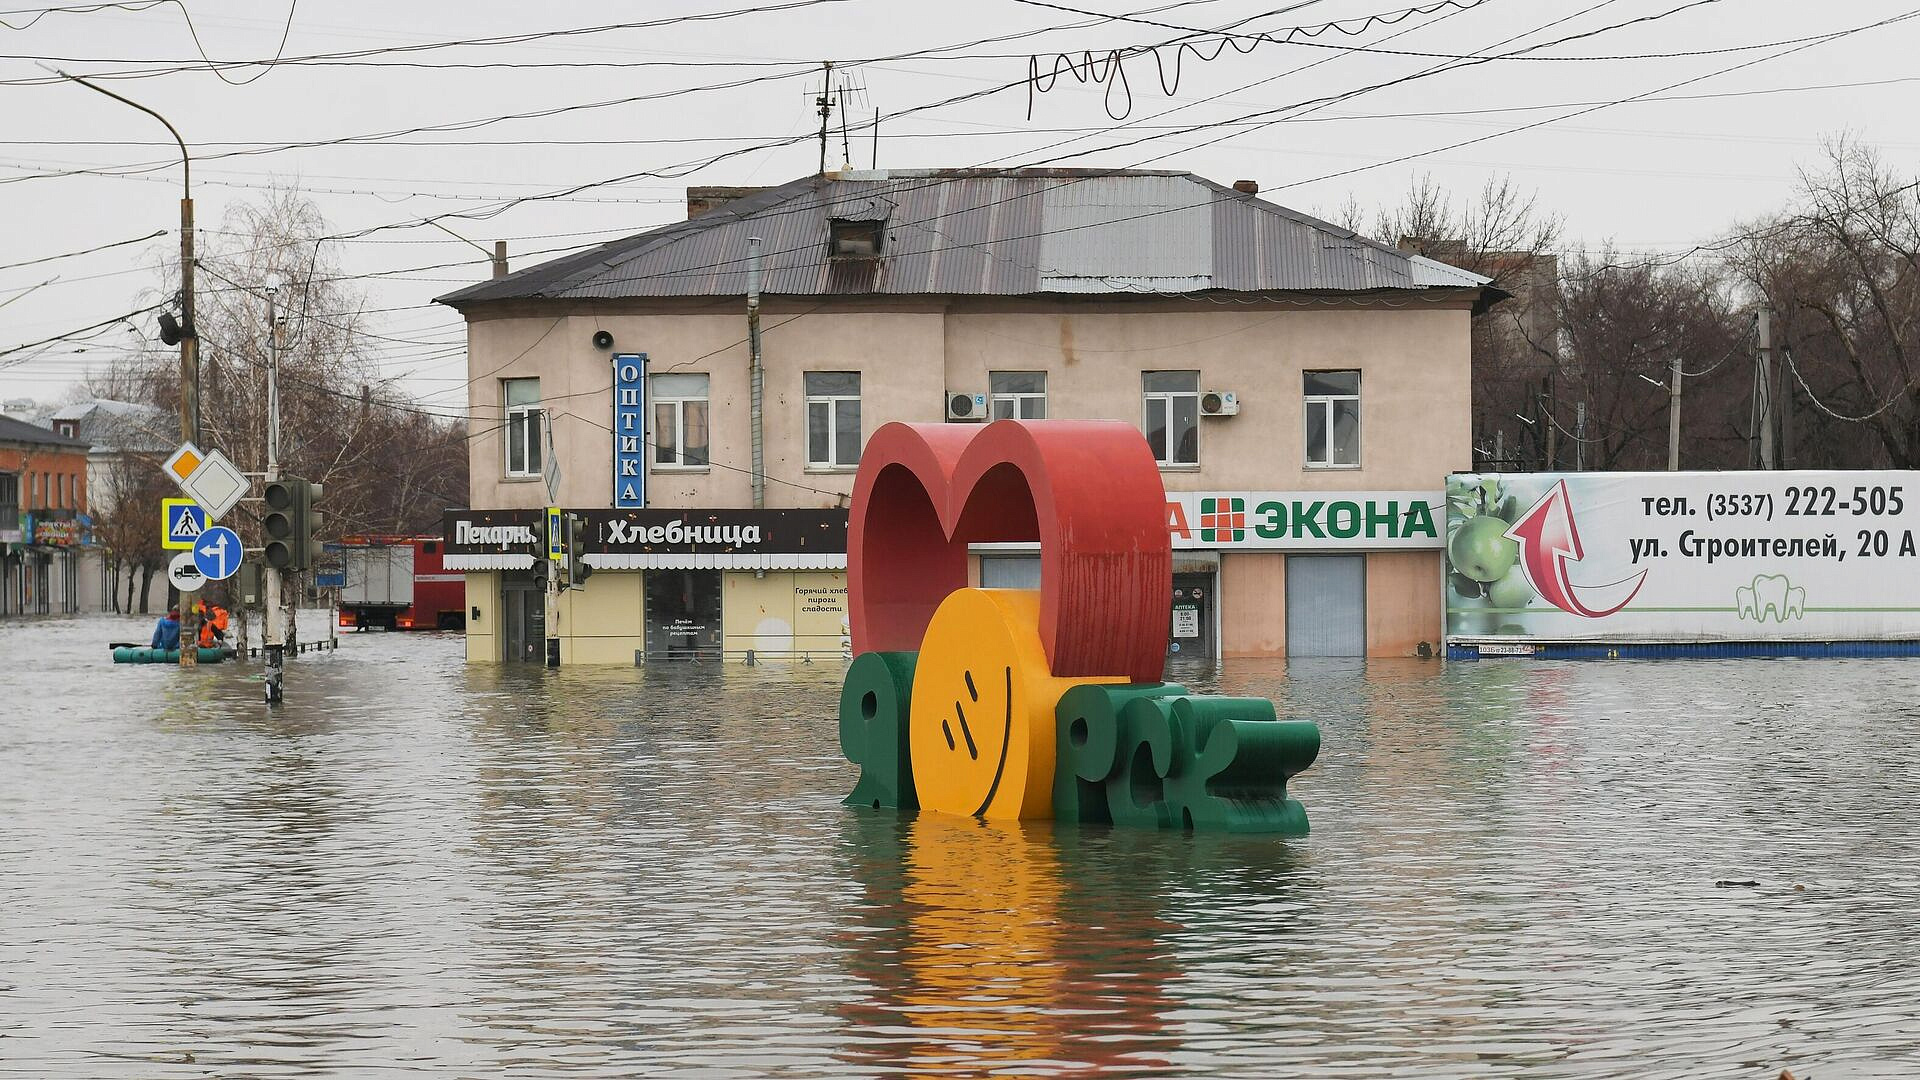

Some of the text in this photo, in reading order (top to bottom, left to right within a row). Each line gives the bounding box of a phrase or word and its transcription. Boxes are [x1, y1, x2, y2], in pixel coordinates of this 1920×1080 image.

[620, 364, 639, 500] ОПТИКА
[1254, 500, 1438, 540] ЭКОНА
[1641, 486, 1904, 522] тел. (3537) 222-505
[607, 518, 762, 548] Хлебница
[1629, 530, 1917, 564] ул. Строителей, 20 А
[795, 587, 827, 595] Горячий
